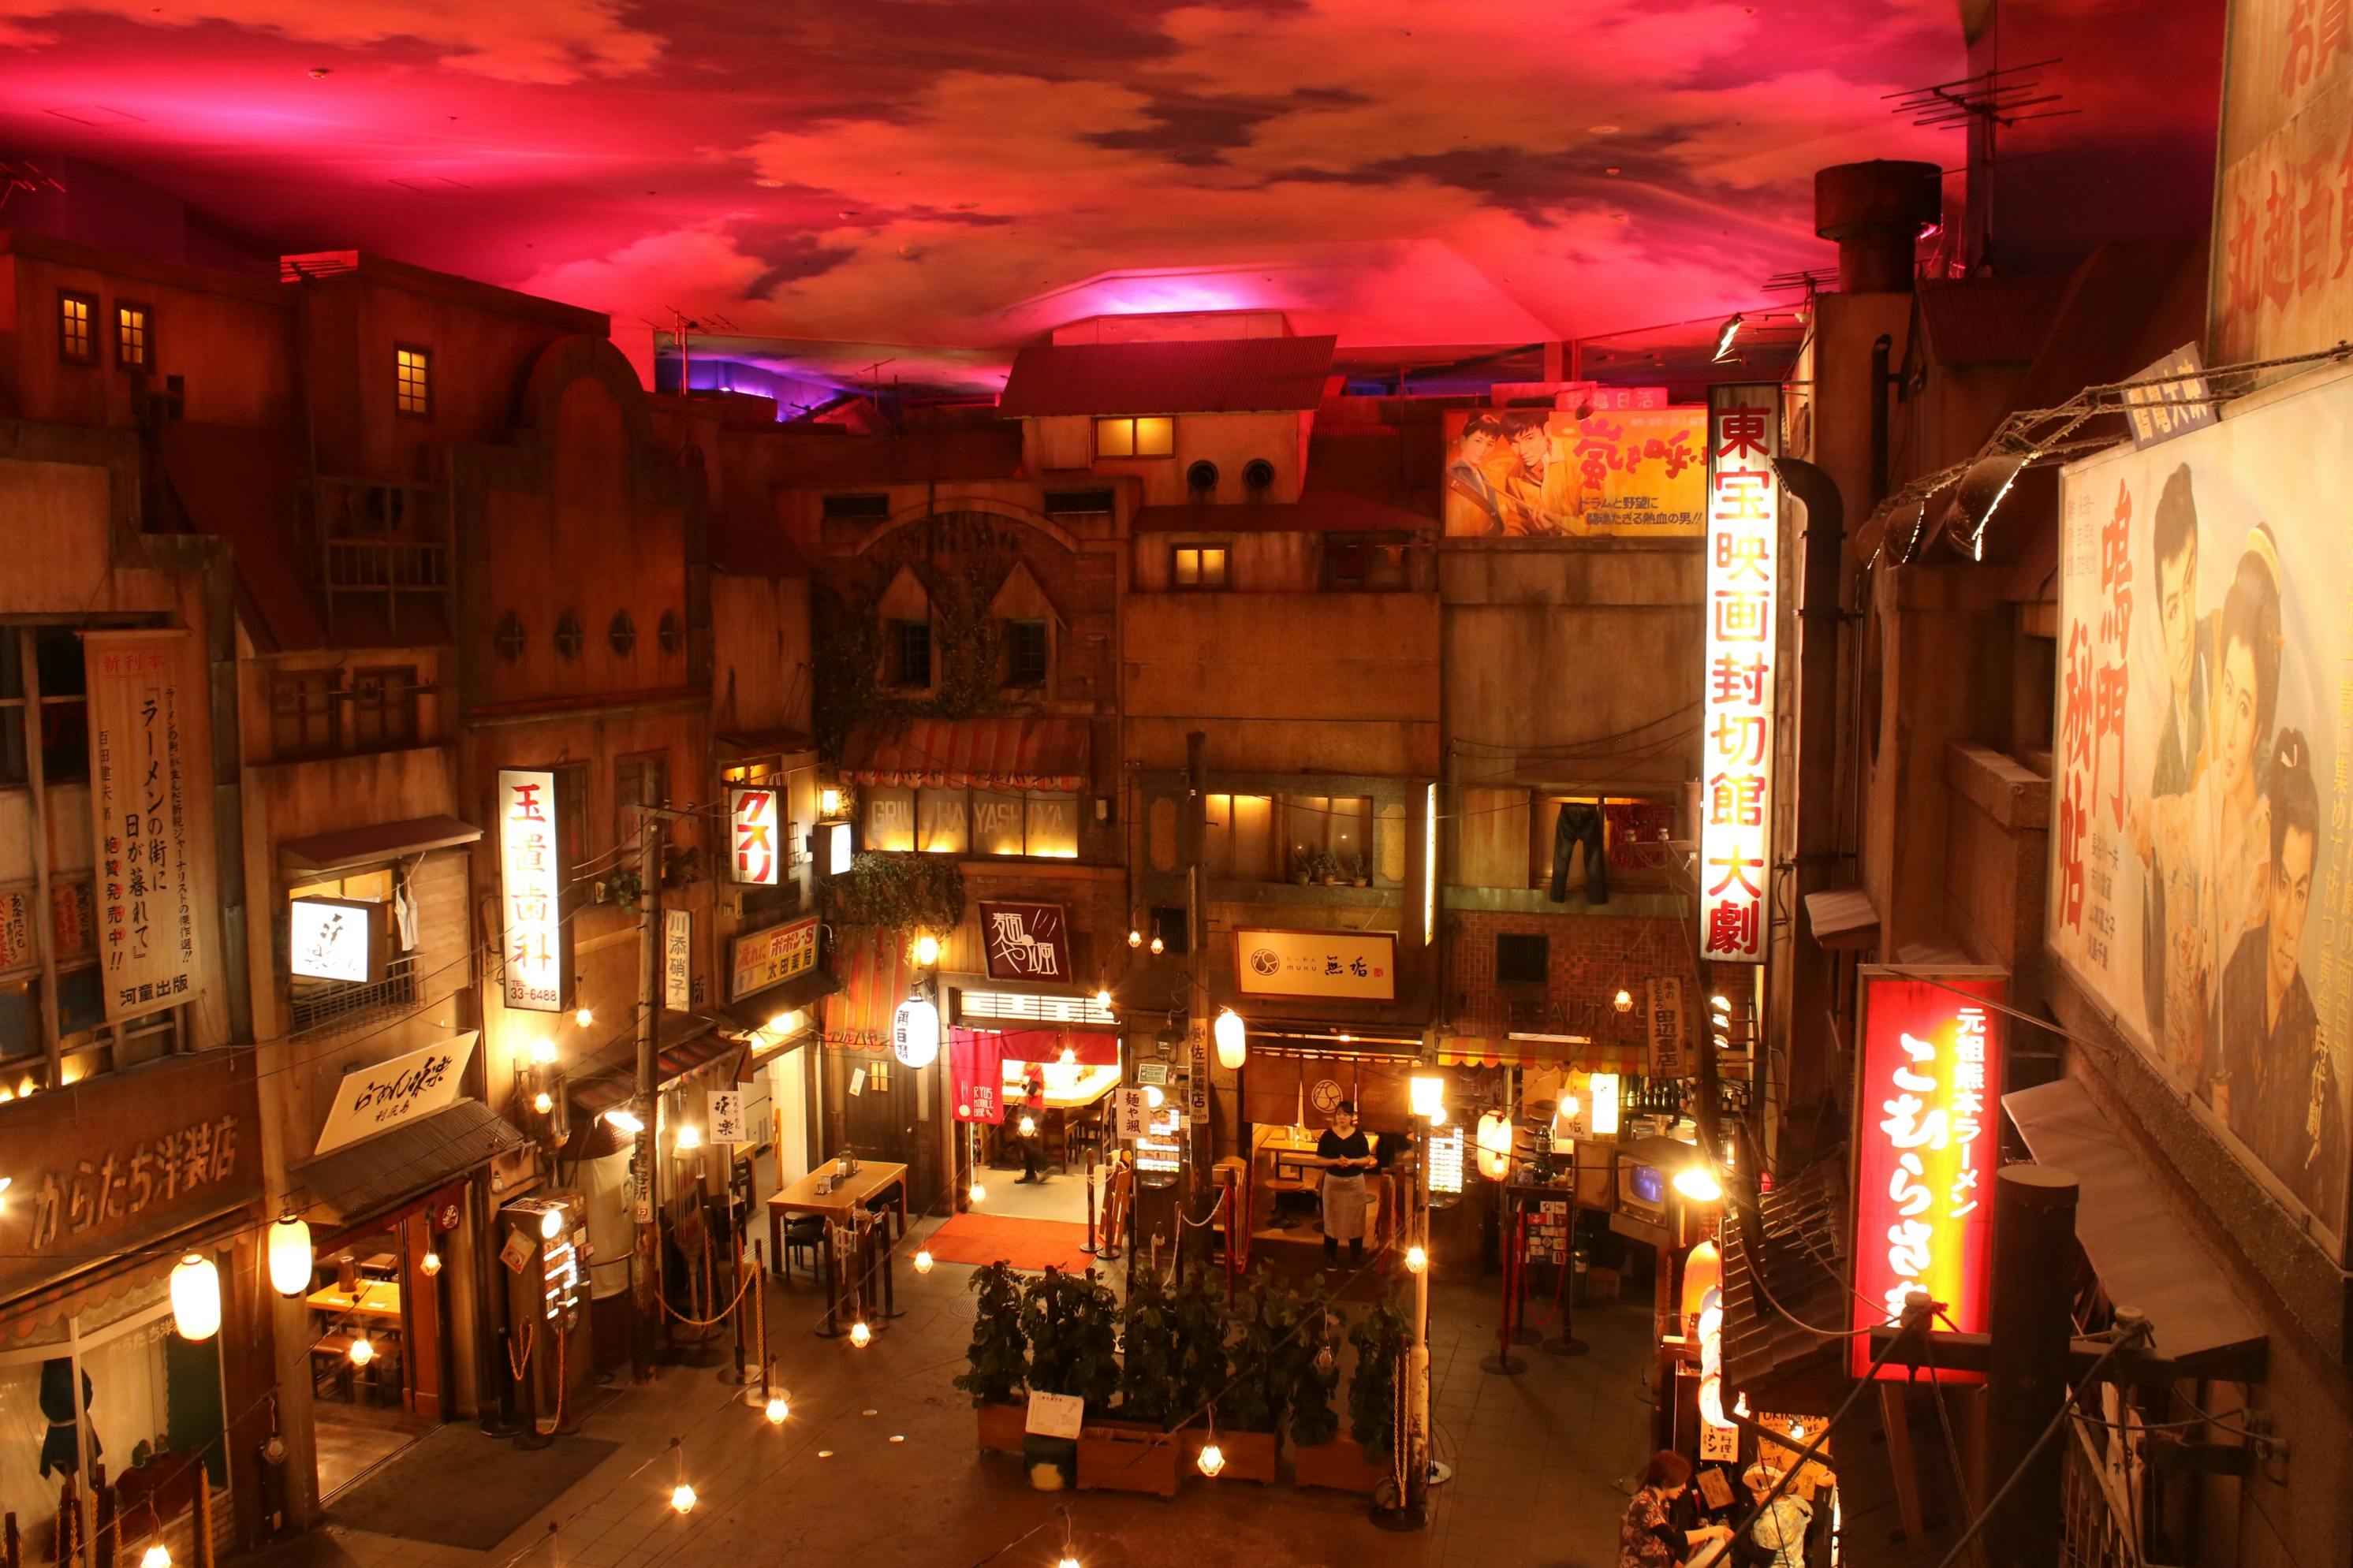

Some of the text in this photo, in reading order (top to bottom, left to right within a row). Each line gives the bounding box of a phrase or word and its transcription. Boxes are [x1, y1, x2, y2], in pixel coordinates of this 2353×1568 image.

[1579, 496, 1658, 516] ドラムと野望に
[103, 655, 166, 672] 新刊本
[2091, 477, 2134, 836] 鳴門
[2059, 617, 2093, 937] 秘帖
[509, 784, 552, 972] 玉置歯科
[736, 791, 771, 882] クスリ
[120, 974, 189, 1007] 河童出版
[510, 987, 557, 1002] 33-6488
[669, 915, 687, 996] 川添硝子
[767, 948, 814, 981] 太田薬局
[1950, 1007, 1986, 1217] 元祖熊本ラーメン
[30, 1115, 237, 1250] からたち洋装店
